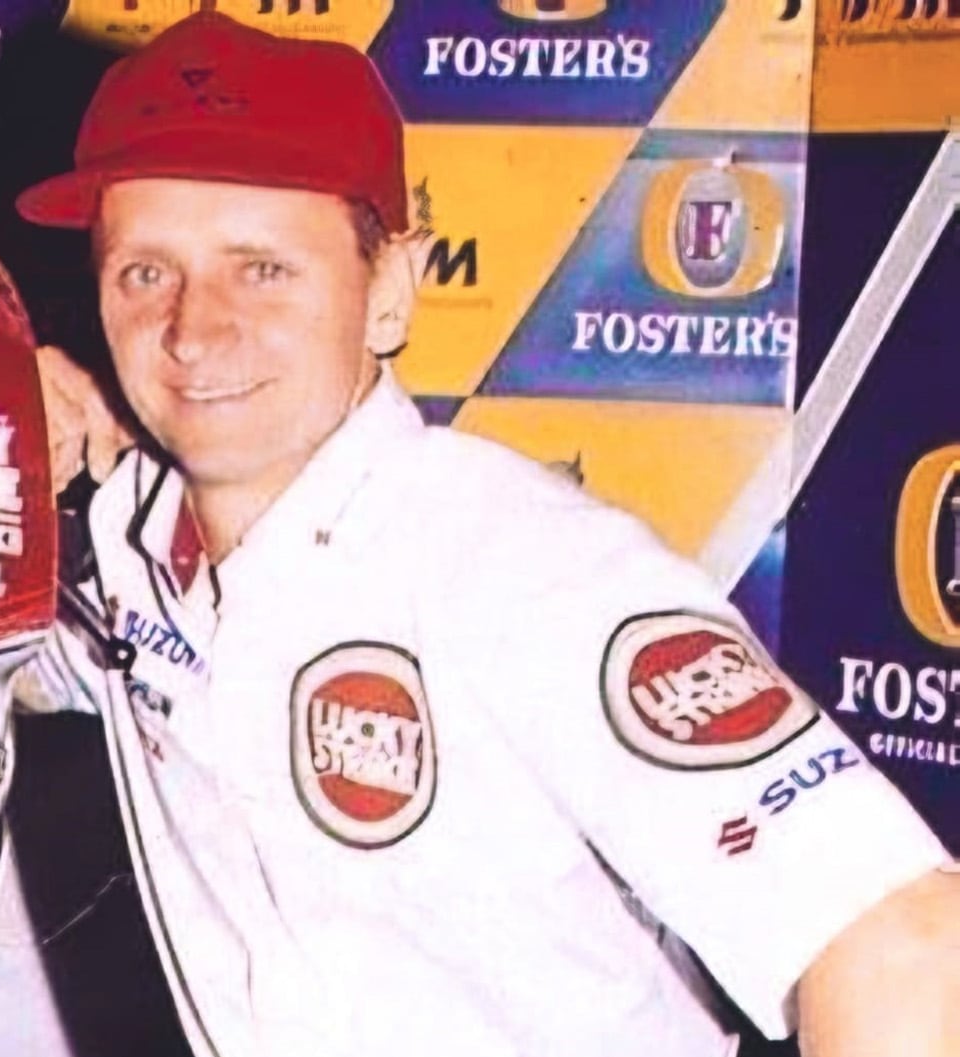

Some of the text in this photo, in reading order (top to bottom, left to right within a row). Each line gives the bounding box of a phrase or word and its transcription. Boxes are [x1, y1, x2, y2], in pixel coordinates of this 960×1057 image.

[424, 34, 650, 78] FOSTER'S
[572, 311, 798, 357] FOSTER'S
[836, 656, 960, 727] FOS
